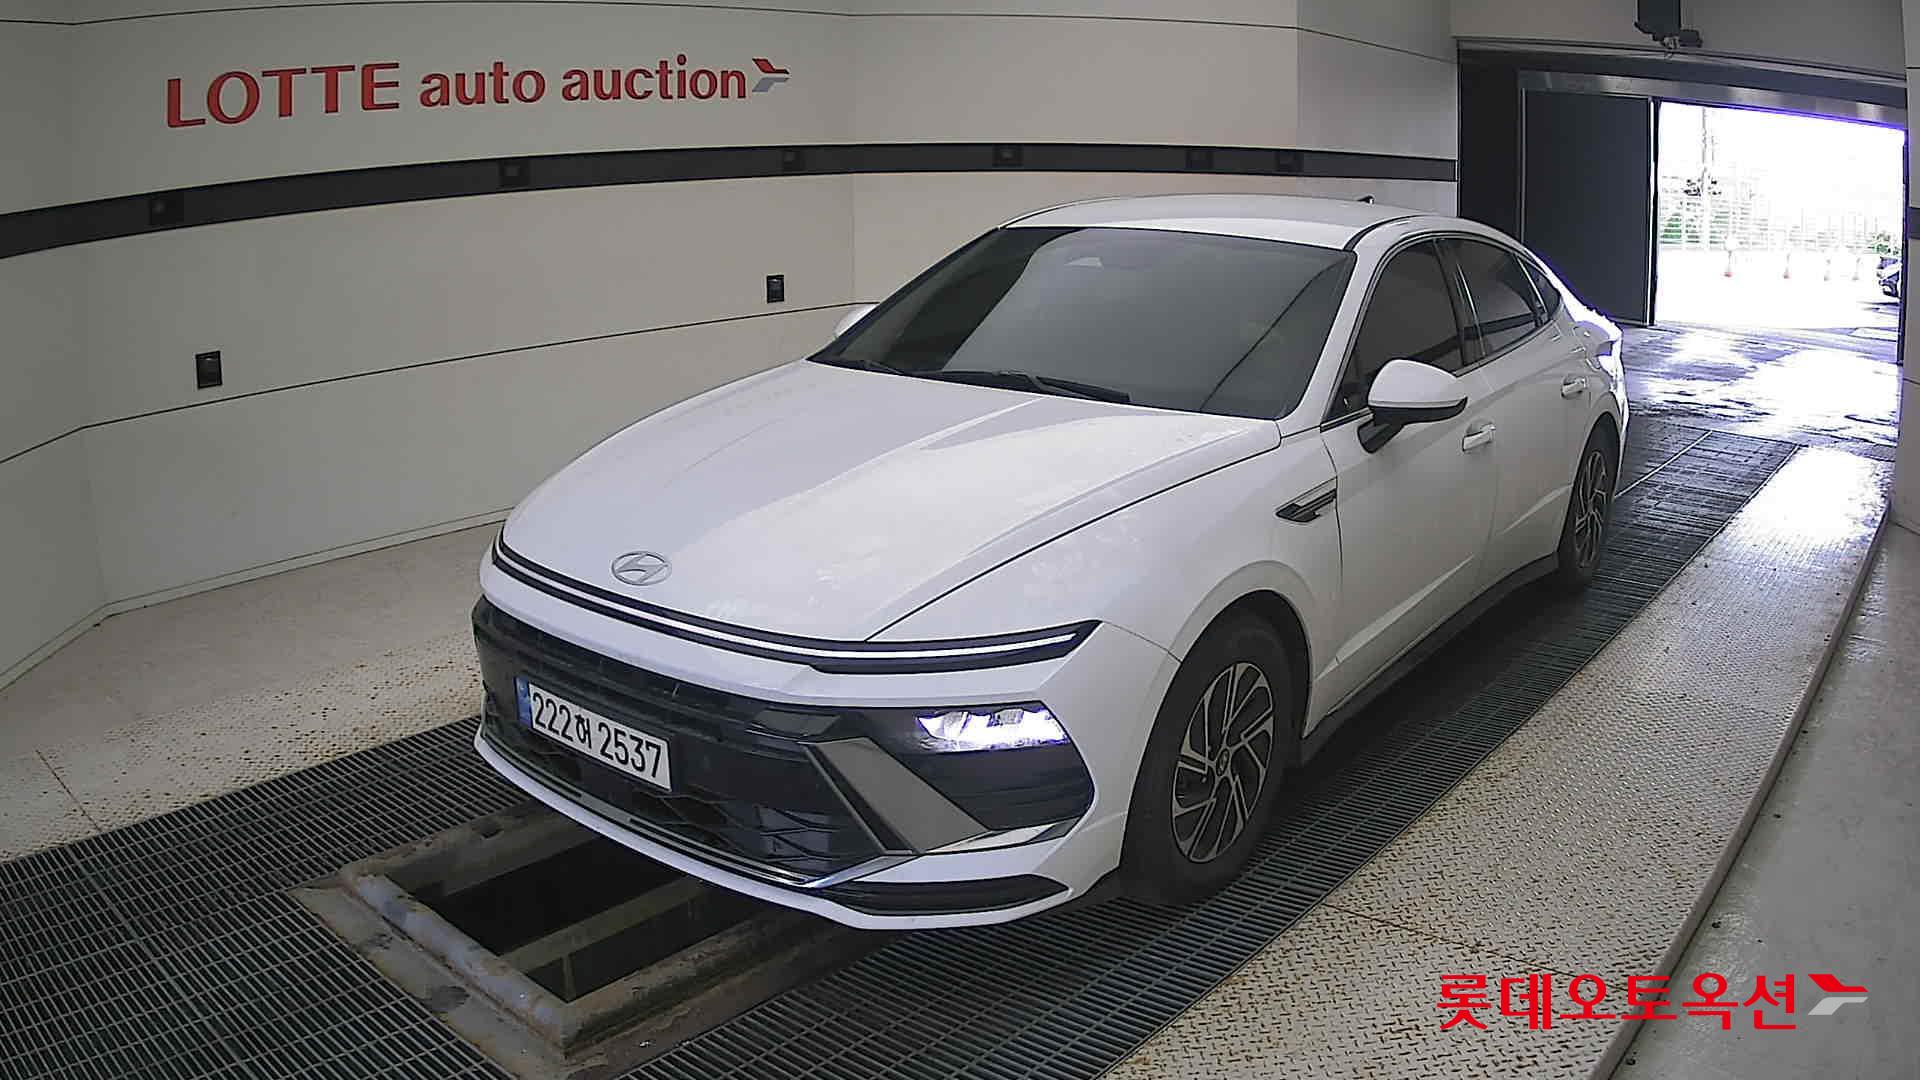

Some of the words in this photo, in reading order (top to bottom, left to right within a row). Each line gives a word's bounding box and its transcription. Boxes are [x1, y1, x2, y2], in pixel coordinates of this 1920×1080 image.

[167, 63, 400, 128] LOTTE
[420, 61, 545, 108] auto
[561, 53, 746, 101] auction
[532, 692, 593, 749] 222허
[598, 722, 662, 778] 2537
